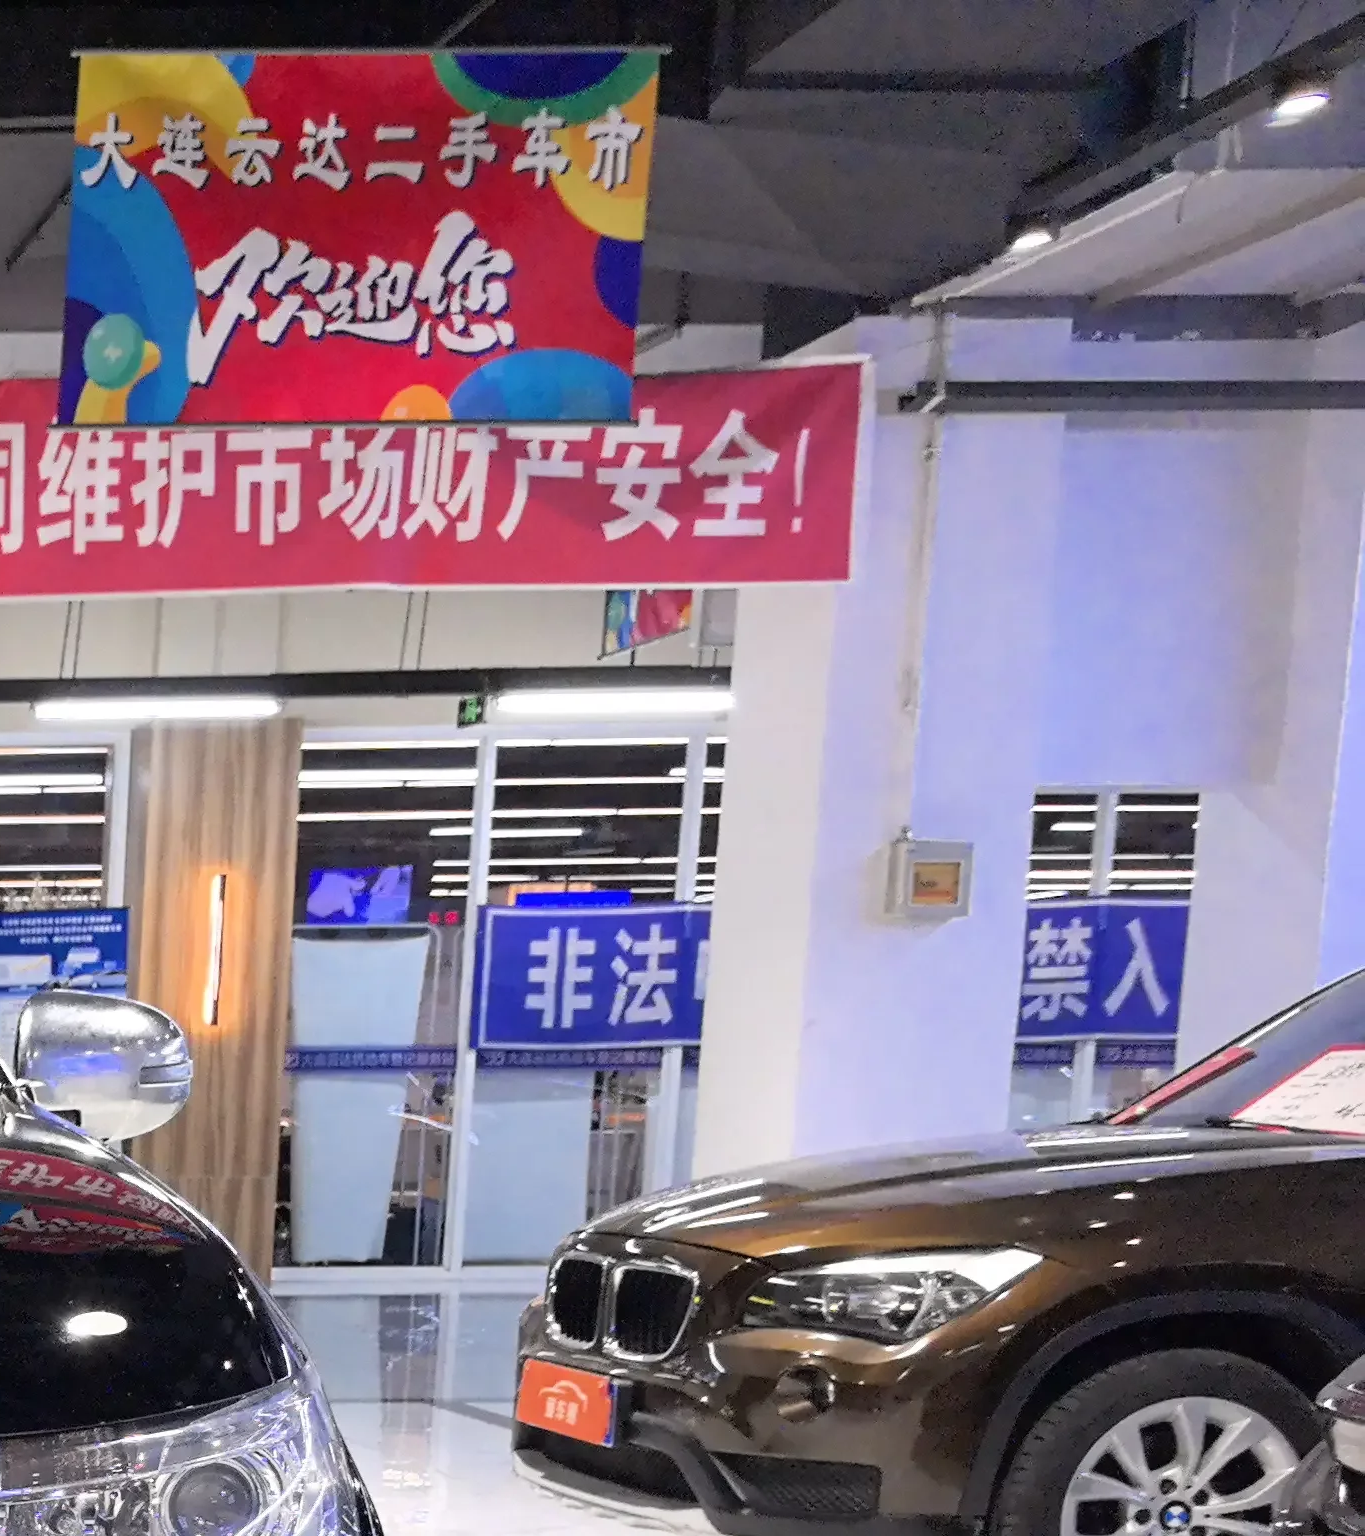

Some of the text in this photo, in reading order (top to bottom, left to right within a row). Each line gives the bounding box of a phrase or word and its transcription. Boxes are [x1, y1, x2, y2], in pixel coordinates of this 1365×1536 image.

[80, 105, 646, 192] 大连云达二手车市
[186, 209, 516, 388] 欢迎您
[523, 922, 710, 1029] 非法
[1019, 916, 1171, 1022] 禁入
